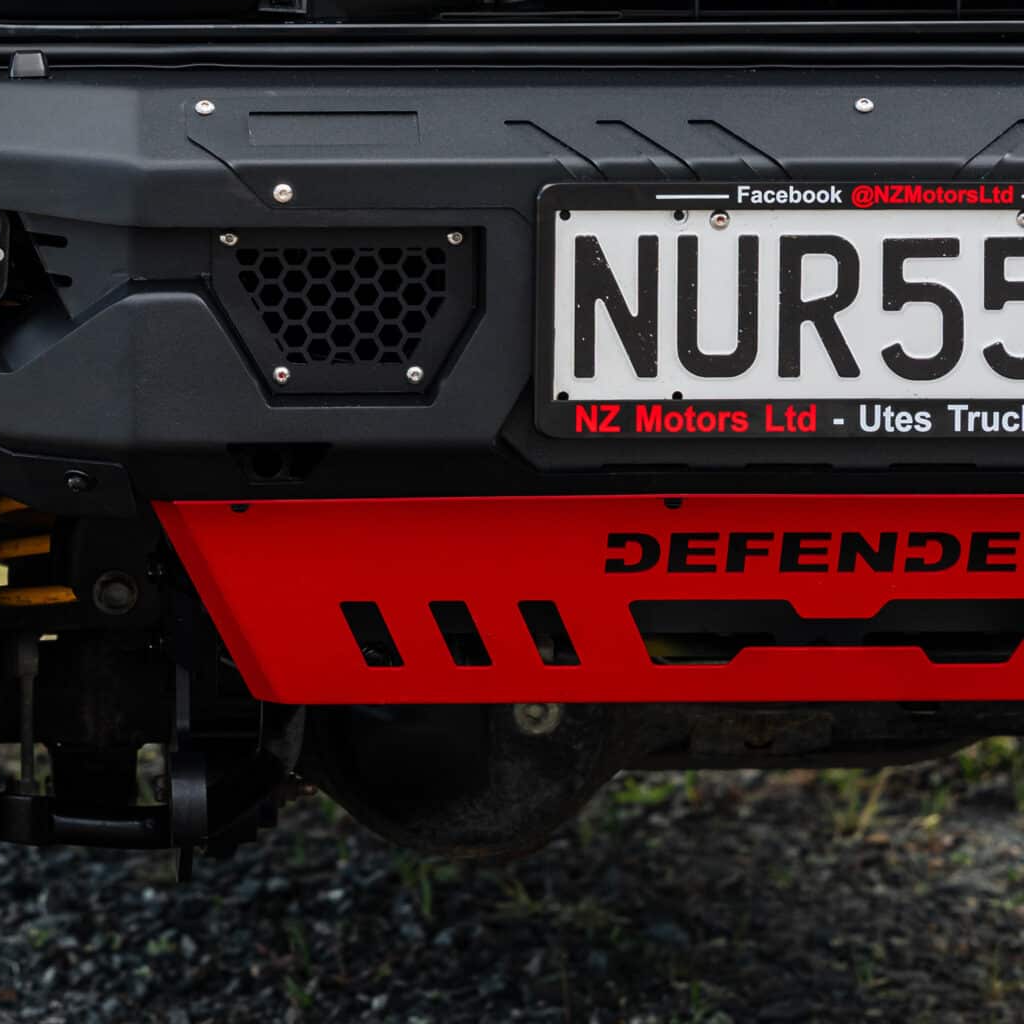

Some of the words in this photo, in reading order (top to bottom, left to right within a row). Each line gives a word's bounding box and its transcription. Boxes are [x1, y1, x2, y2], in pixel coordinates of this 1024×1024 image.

[736, 185, 843, 204] Facebook
[851, 185, 1015, 208] @NZMotorsLtd
[575, 404, 621, 433] NZ
[635, 404, 749, 433] Motors
[765, 403, 817, 433] Ltd
[859, 404, 932, 433] Utes
[947, 404, 1024, 433] Truc
[604, 531, 1022, 574] DEFENDE
